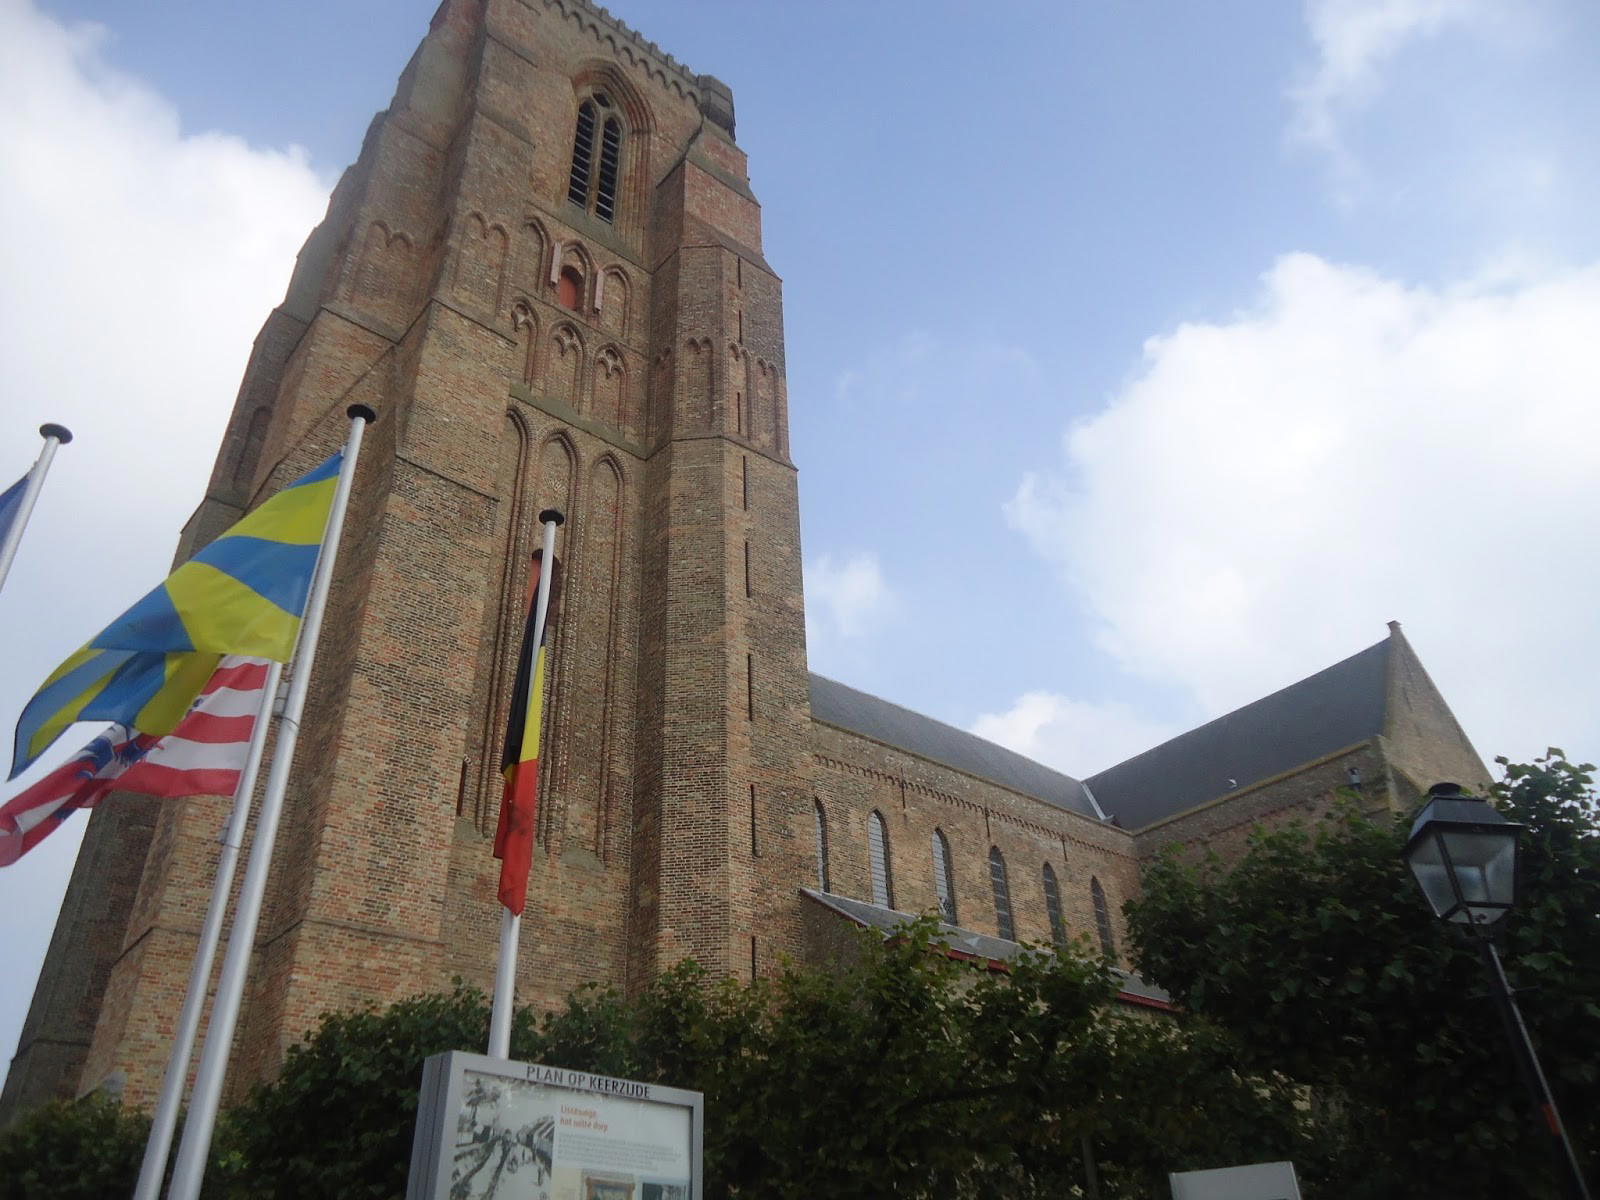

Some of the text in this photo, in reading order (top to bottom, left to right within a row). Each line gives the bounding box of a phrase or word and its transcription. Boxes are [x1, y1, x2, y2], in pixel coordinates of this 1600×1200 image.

[526, 1065, 650, 1097] PLAN OP KEERZIJDE
